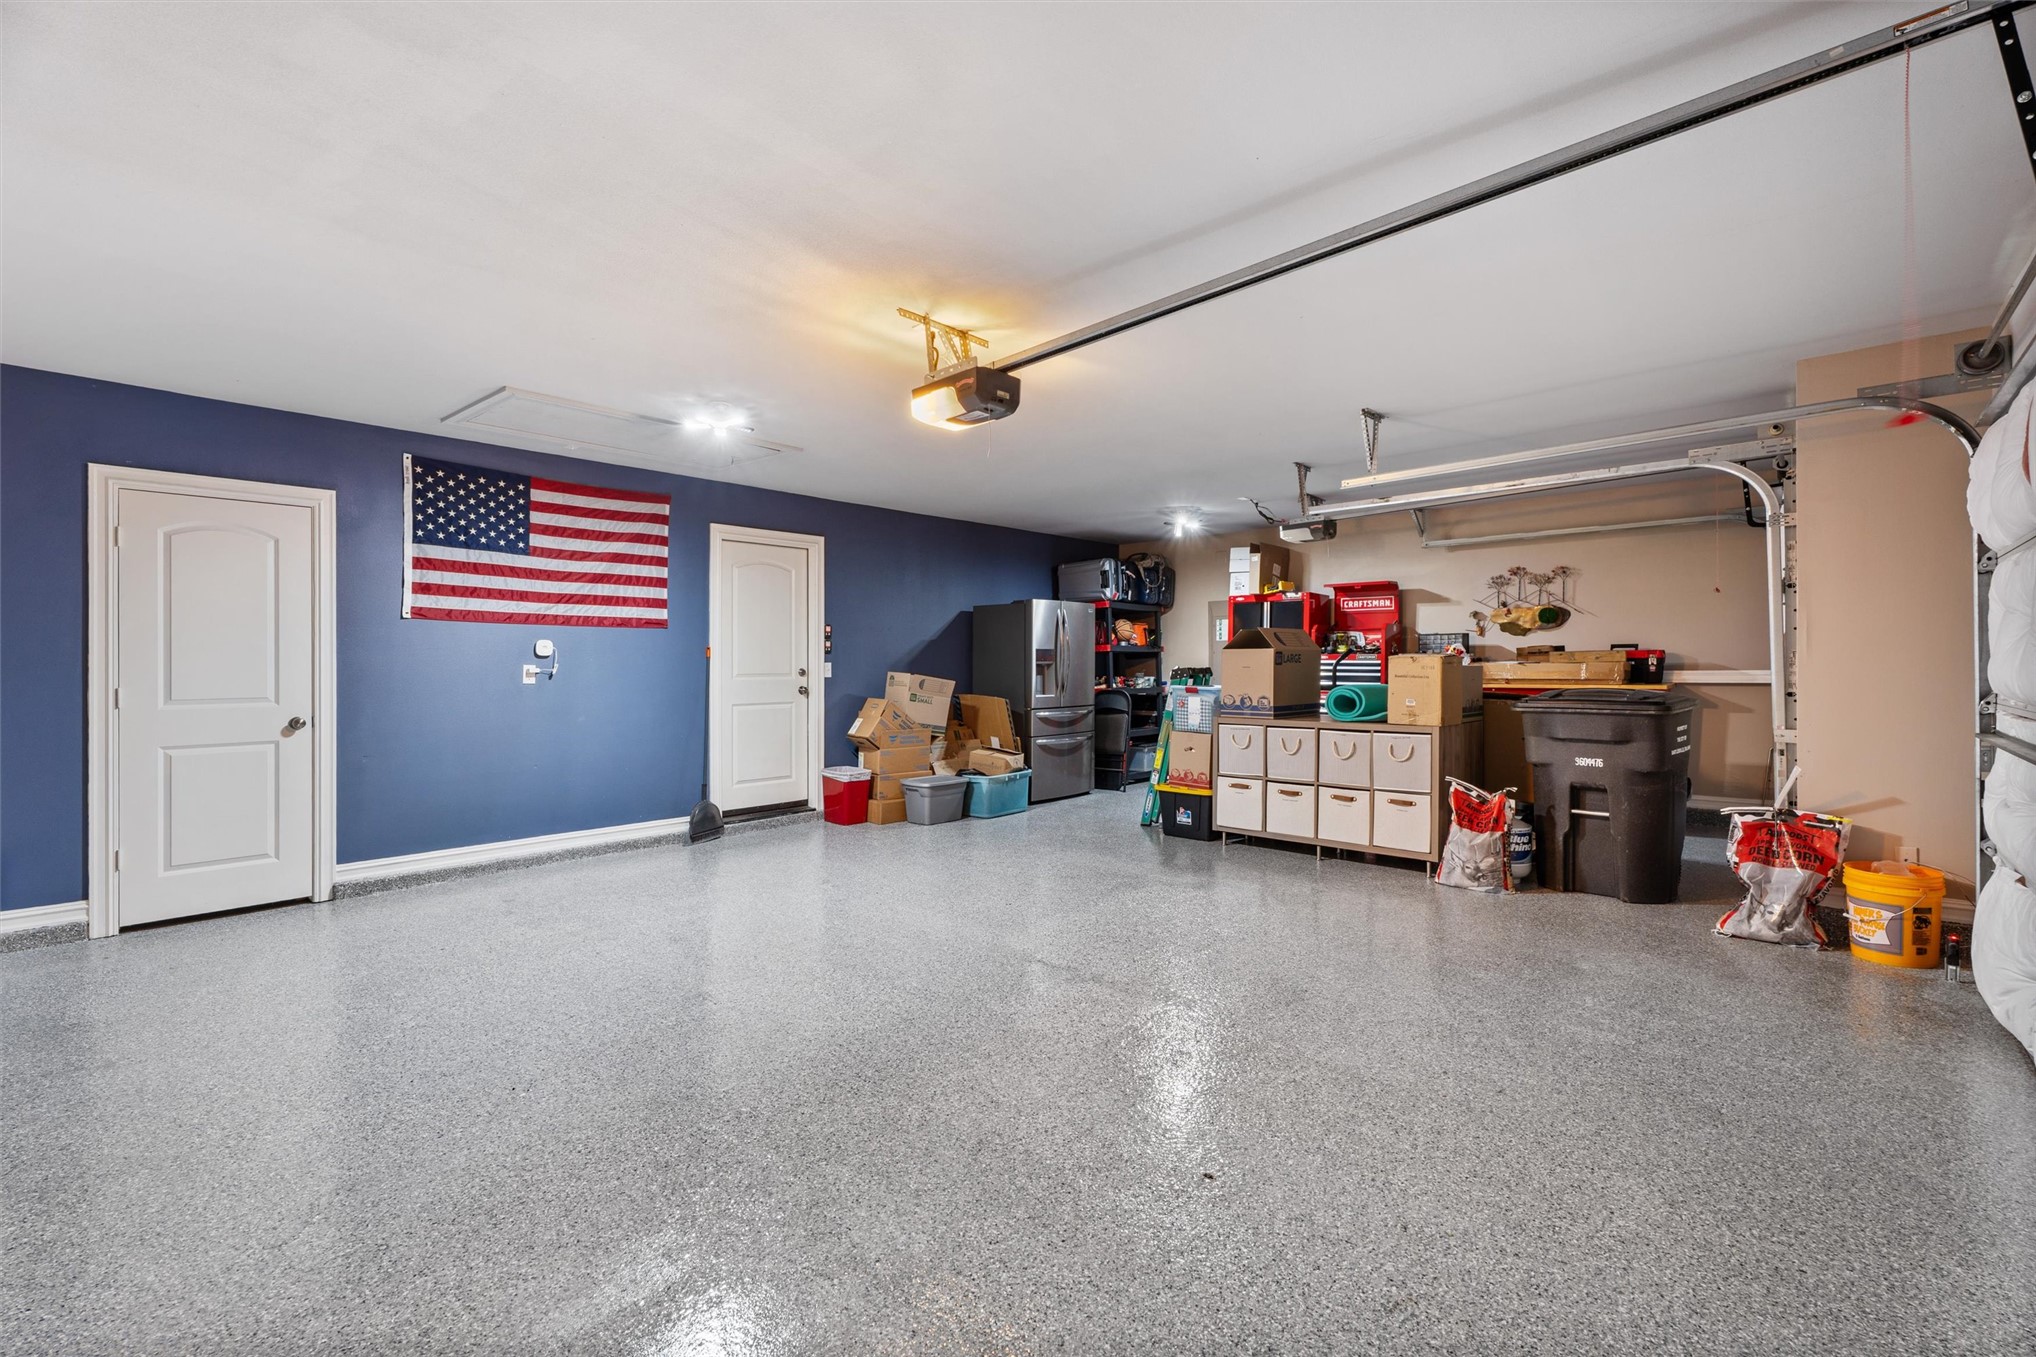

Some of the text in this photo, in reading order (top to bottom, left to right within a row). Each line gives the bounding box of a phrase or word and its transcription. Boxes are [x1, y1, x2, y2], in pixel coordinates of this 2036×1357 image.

[1344, 599, 1391, 608] CRAFTSMAN
[1283, 654, 1302, 664] LARGE
[917, 697, 933, 705] SMALL
